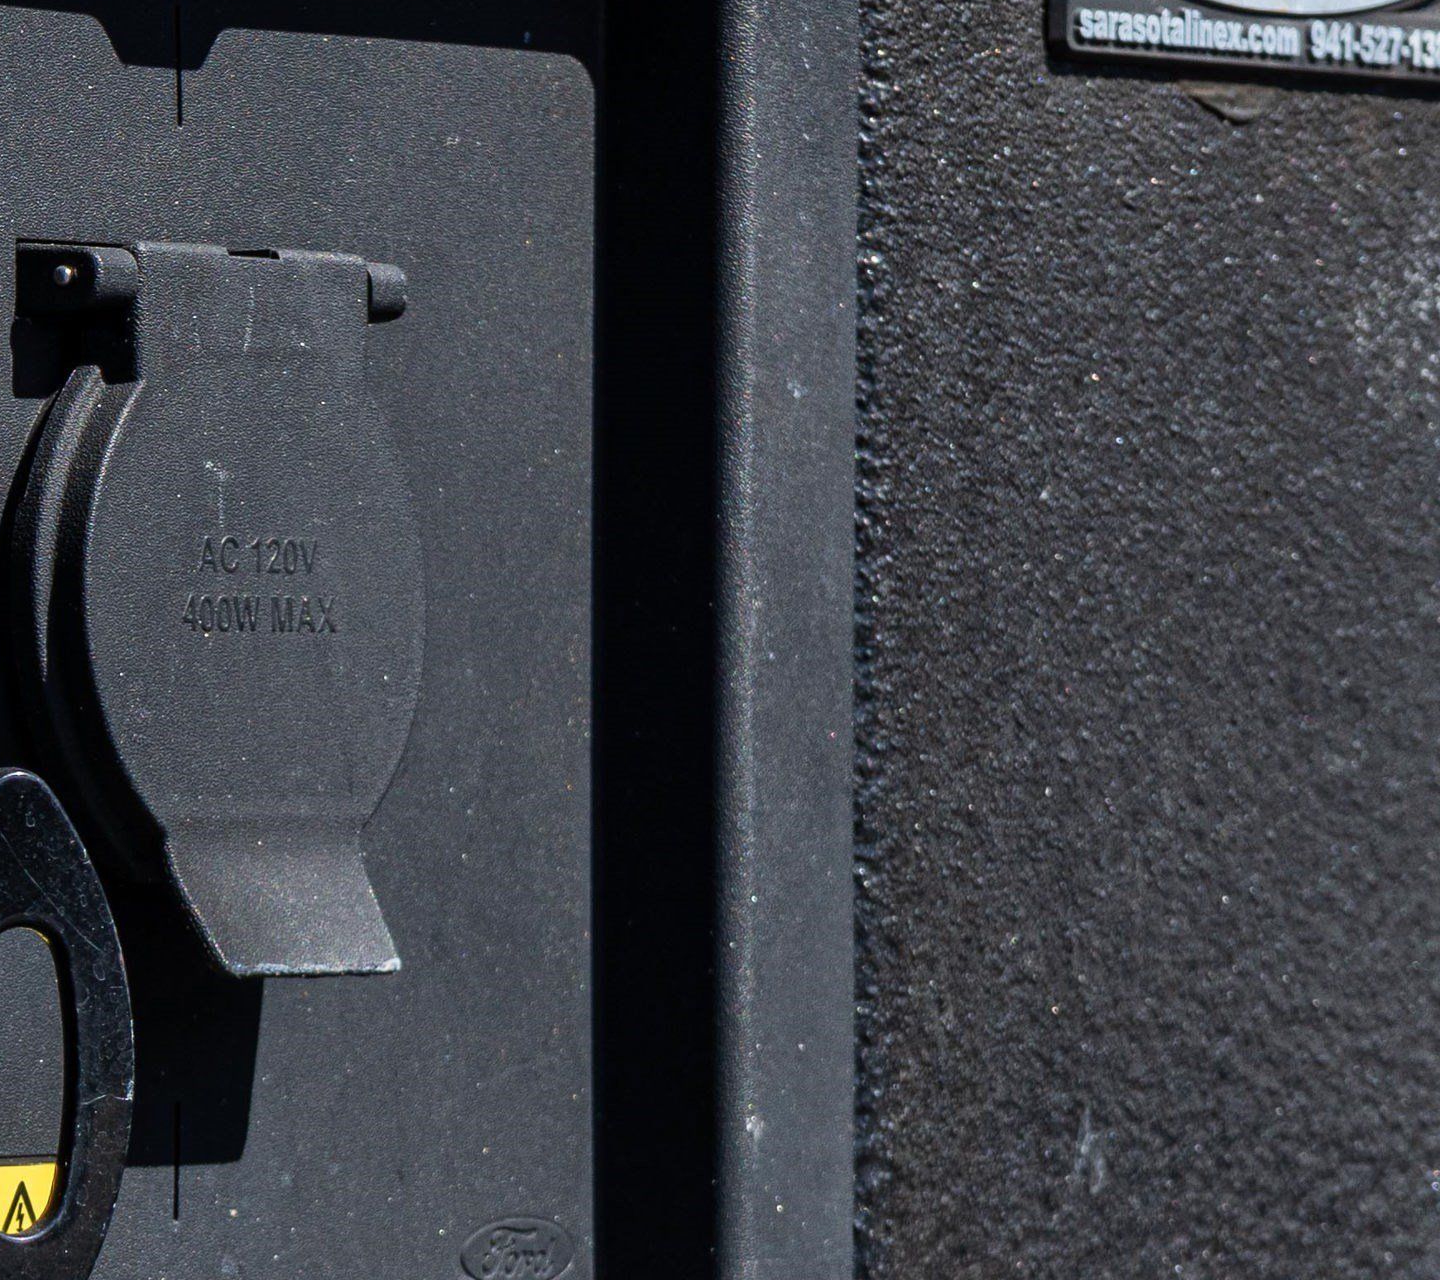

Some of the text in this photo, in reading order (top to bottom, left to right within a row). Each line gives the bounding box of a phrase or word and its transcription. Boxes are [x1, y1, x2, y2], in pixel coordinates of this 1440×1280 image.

[1079, 7, 1301, 56] sarasotalinex.com
[198, 535, 319, 575] AC 120V
[182, 593, 337, 634] 400W MAX
[480, 1224, 557, 1278] Ford
